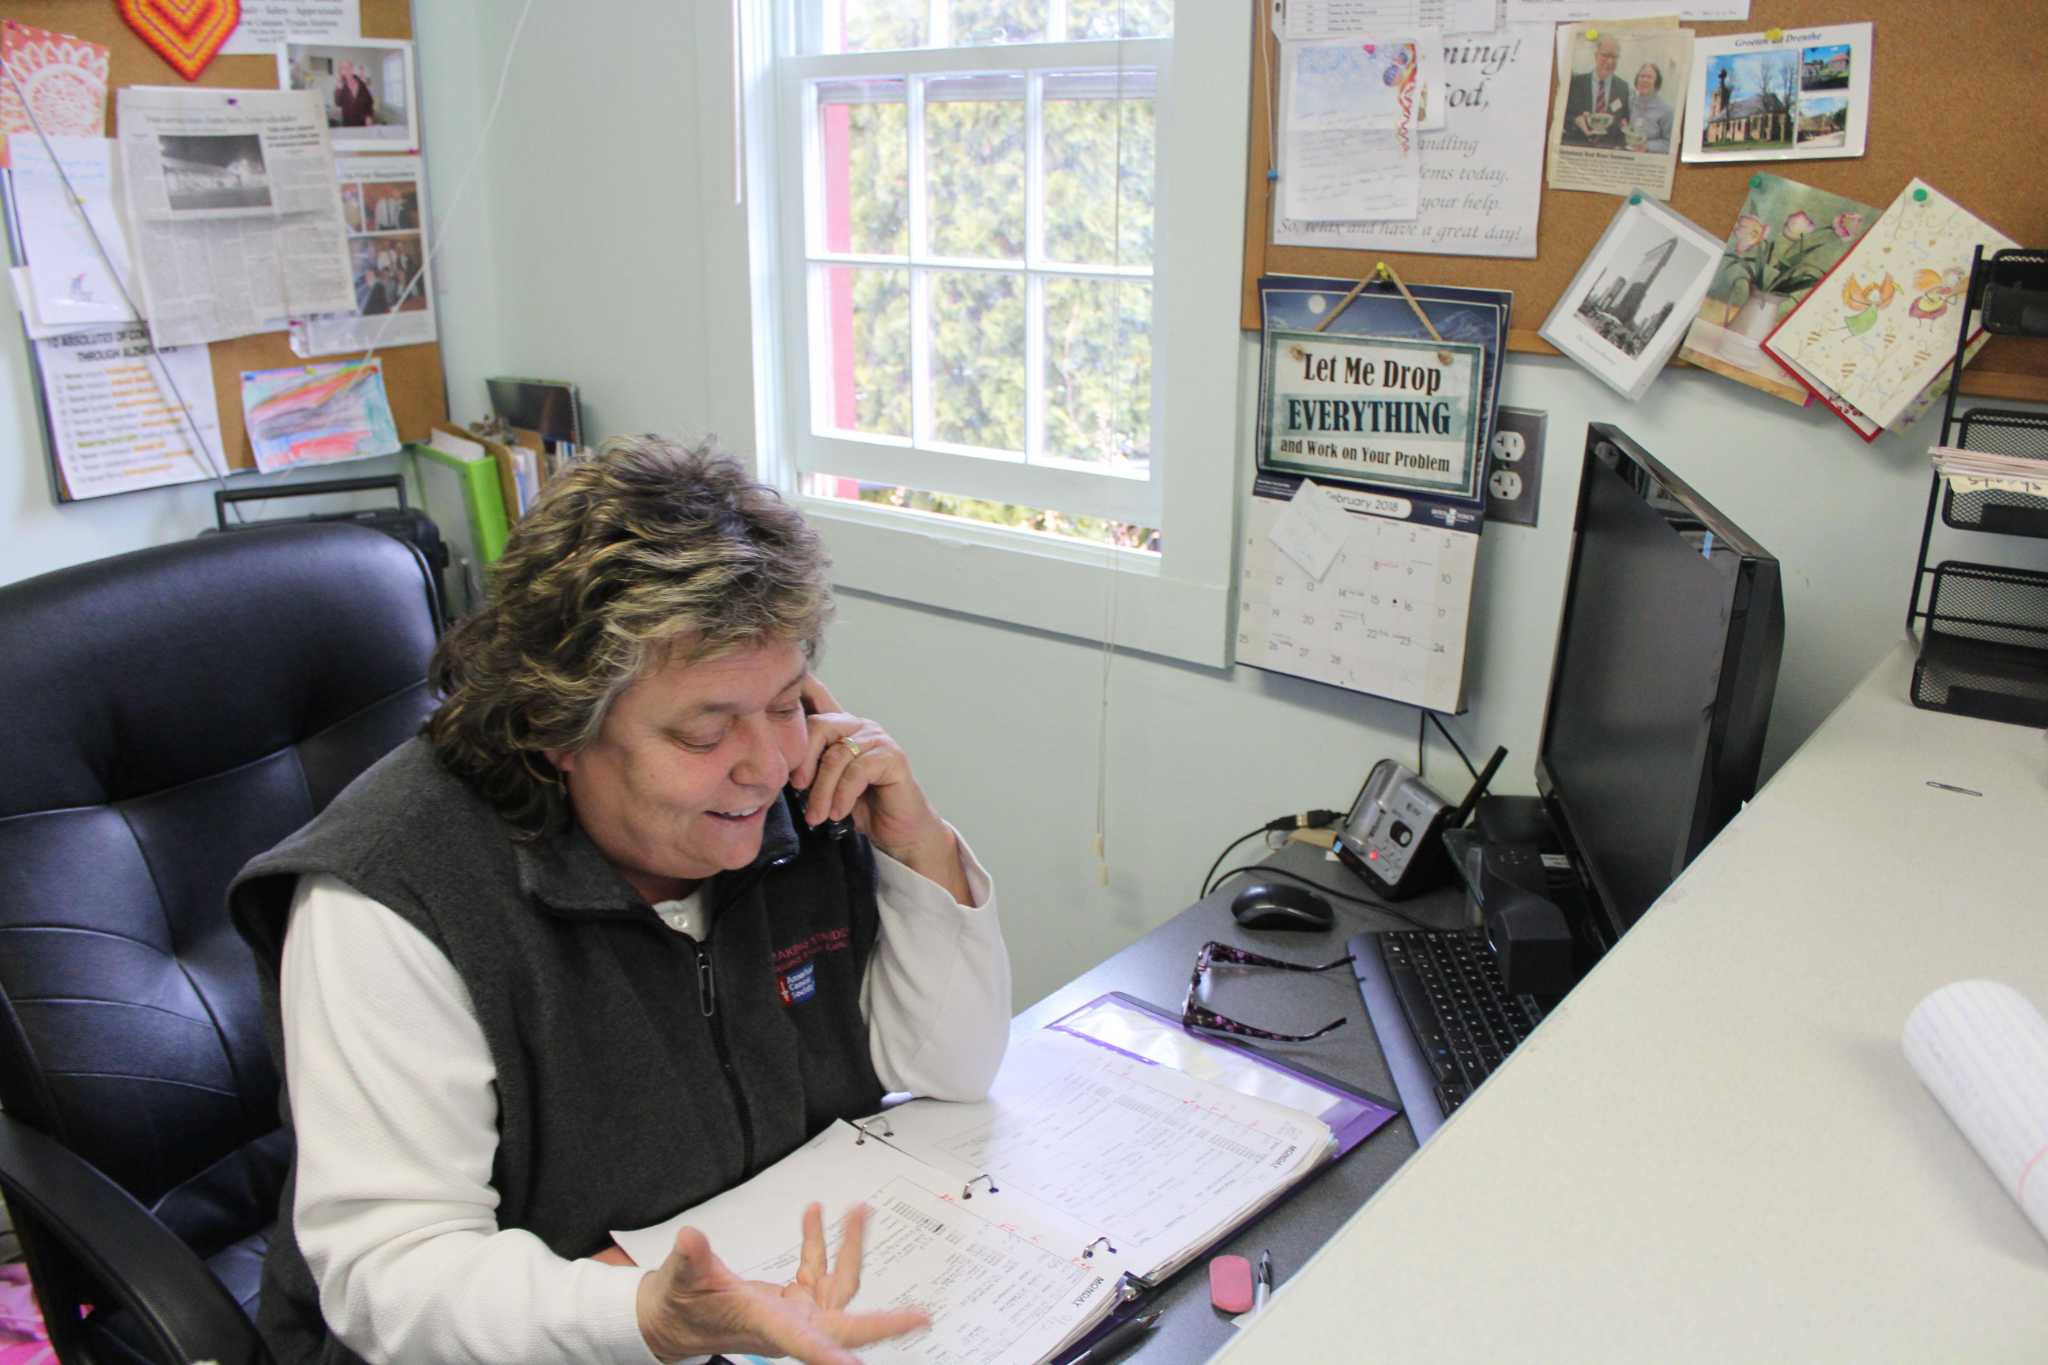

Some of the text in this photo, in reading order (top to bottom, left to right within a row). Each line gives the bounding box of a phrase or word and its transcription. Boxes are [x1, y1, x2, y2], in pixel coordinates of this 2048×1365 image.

[1443, 38, 1522, 76] ning!
[1418, 136, 1479, 159] andling
[1303, 353, 1442, 396] Let Me Drop
[1287, 399, 1450, 436] EVERYTHING
[1280, 437, 1450, 473] and Work on Your Problem
[1375, 499, 1399, 513] 2018
[1073, 1276, 1105, 1308] MONDAY
